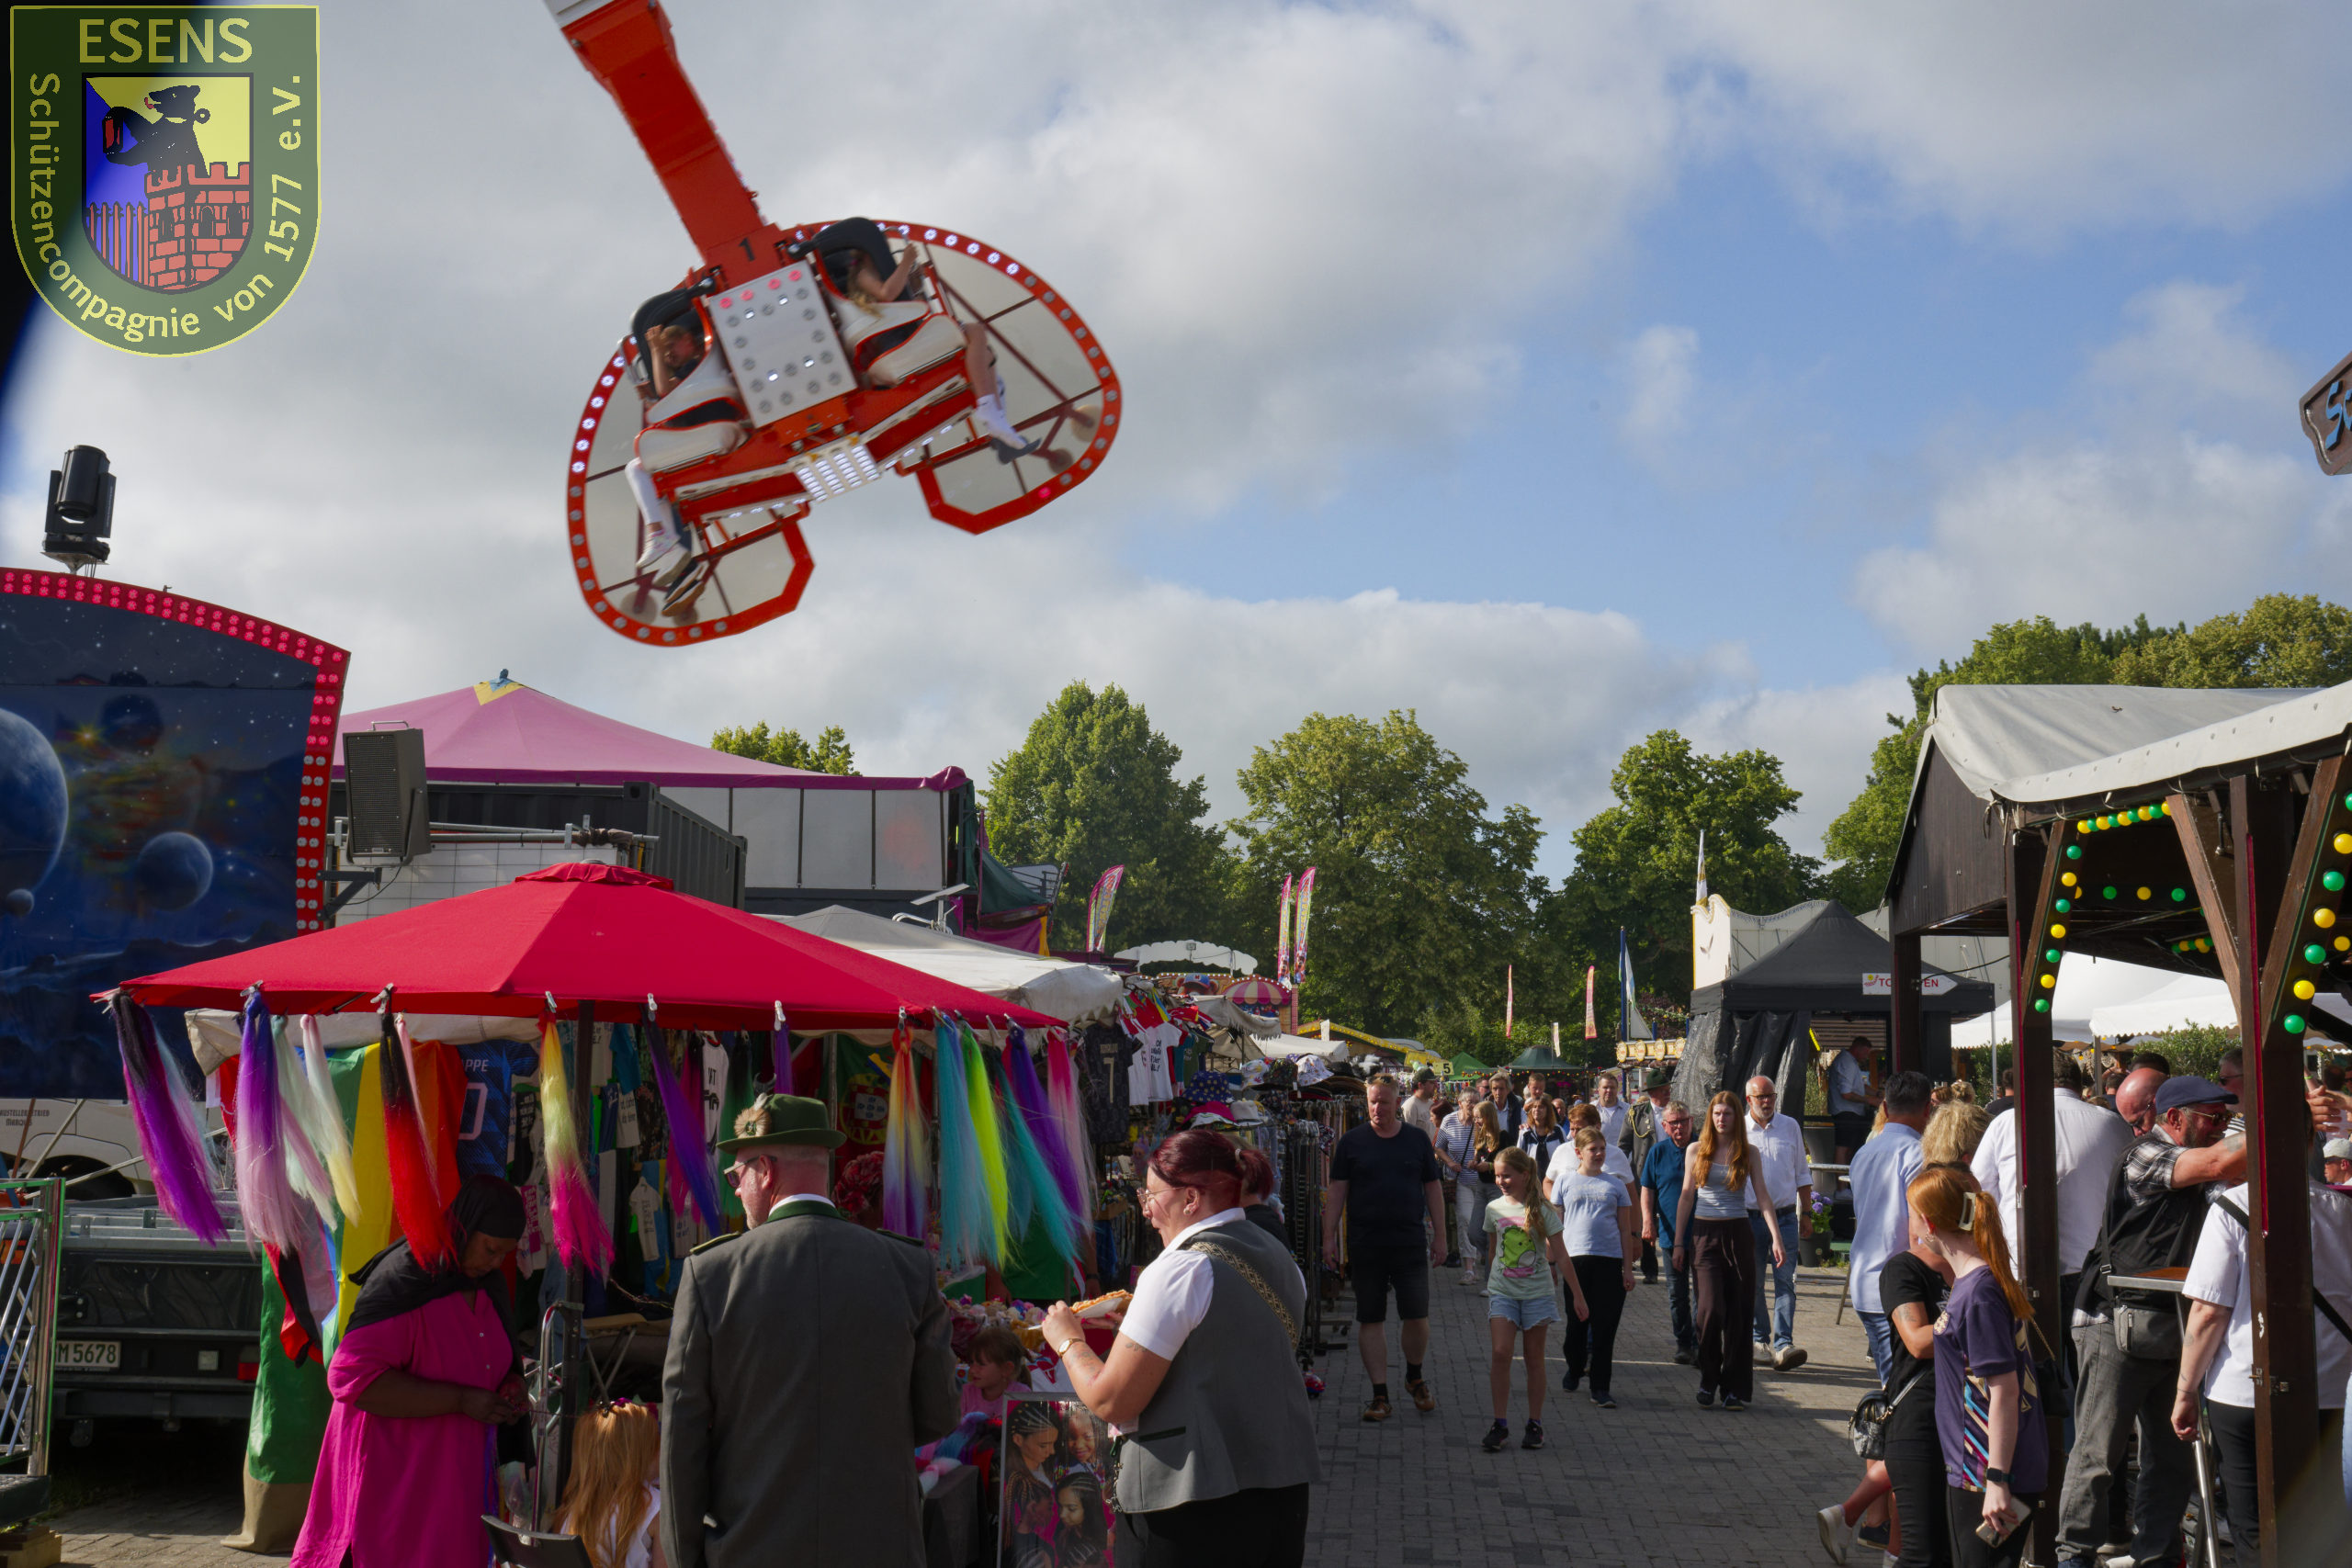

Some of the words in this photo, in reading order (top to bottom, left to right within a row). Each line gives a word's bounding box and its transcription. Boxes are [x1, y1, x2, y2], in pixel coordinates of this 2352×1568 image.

[738, 237, 755, 262] 1
[1103, 1057, 1114, 1103] 7
[1443, 1063, 1451, 1074] 5
[73, 1343, 117, 1364] 5678
